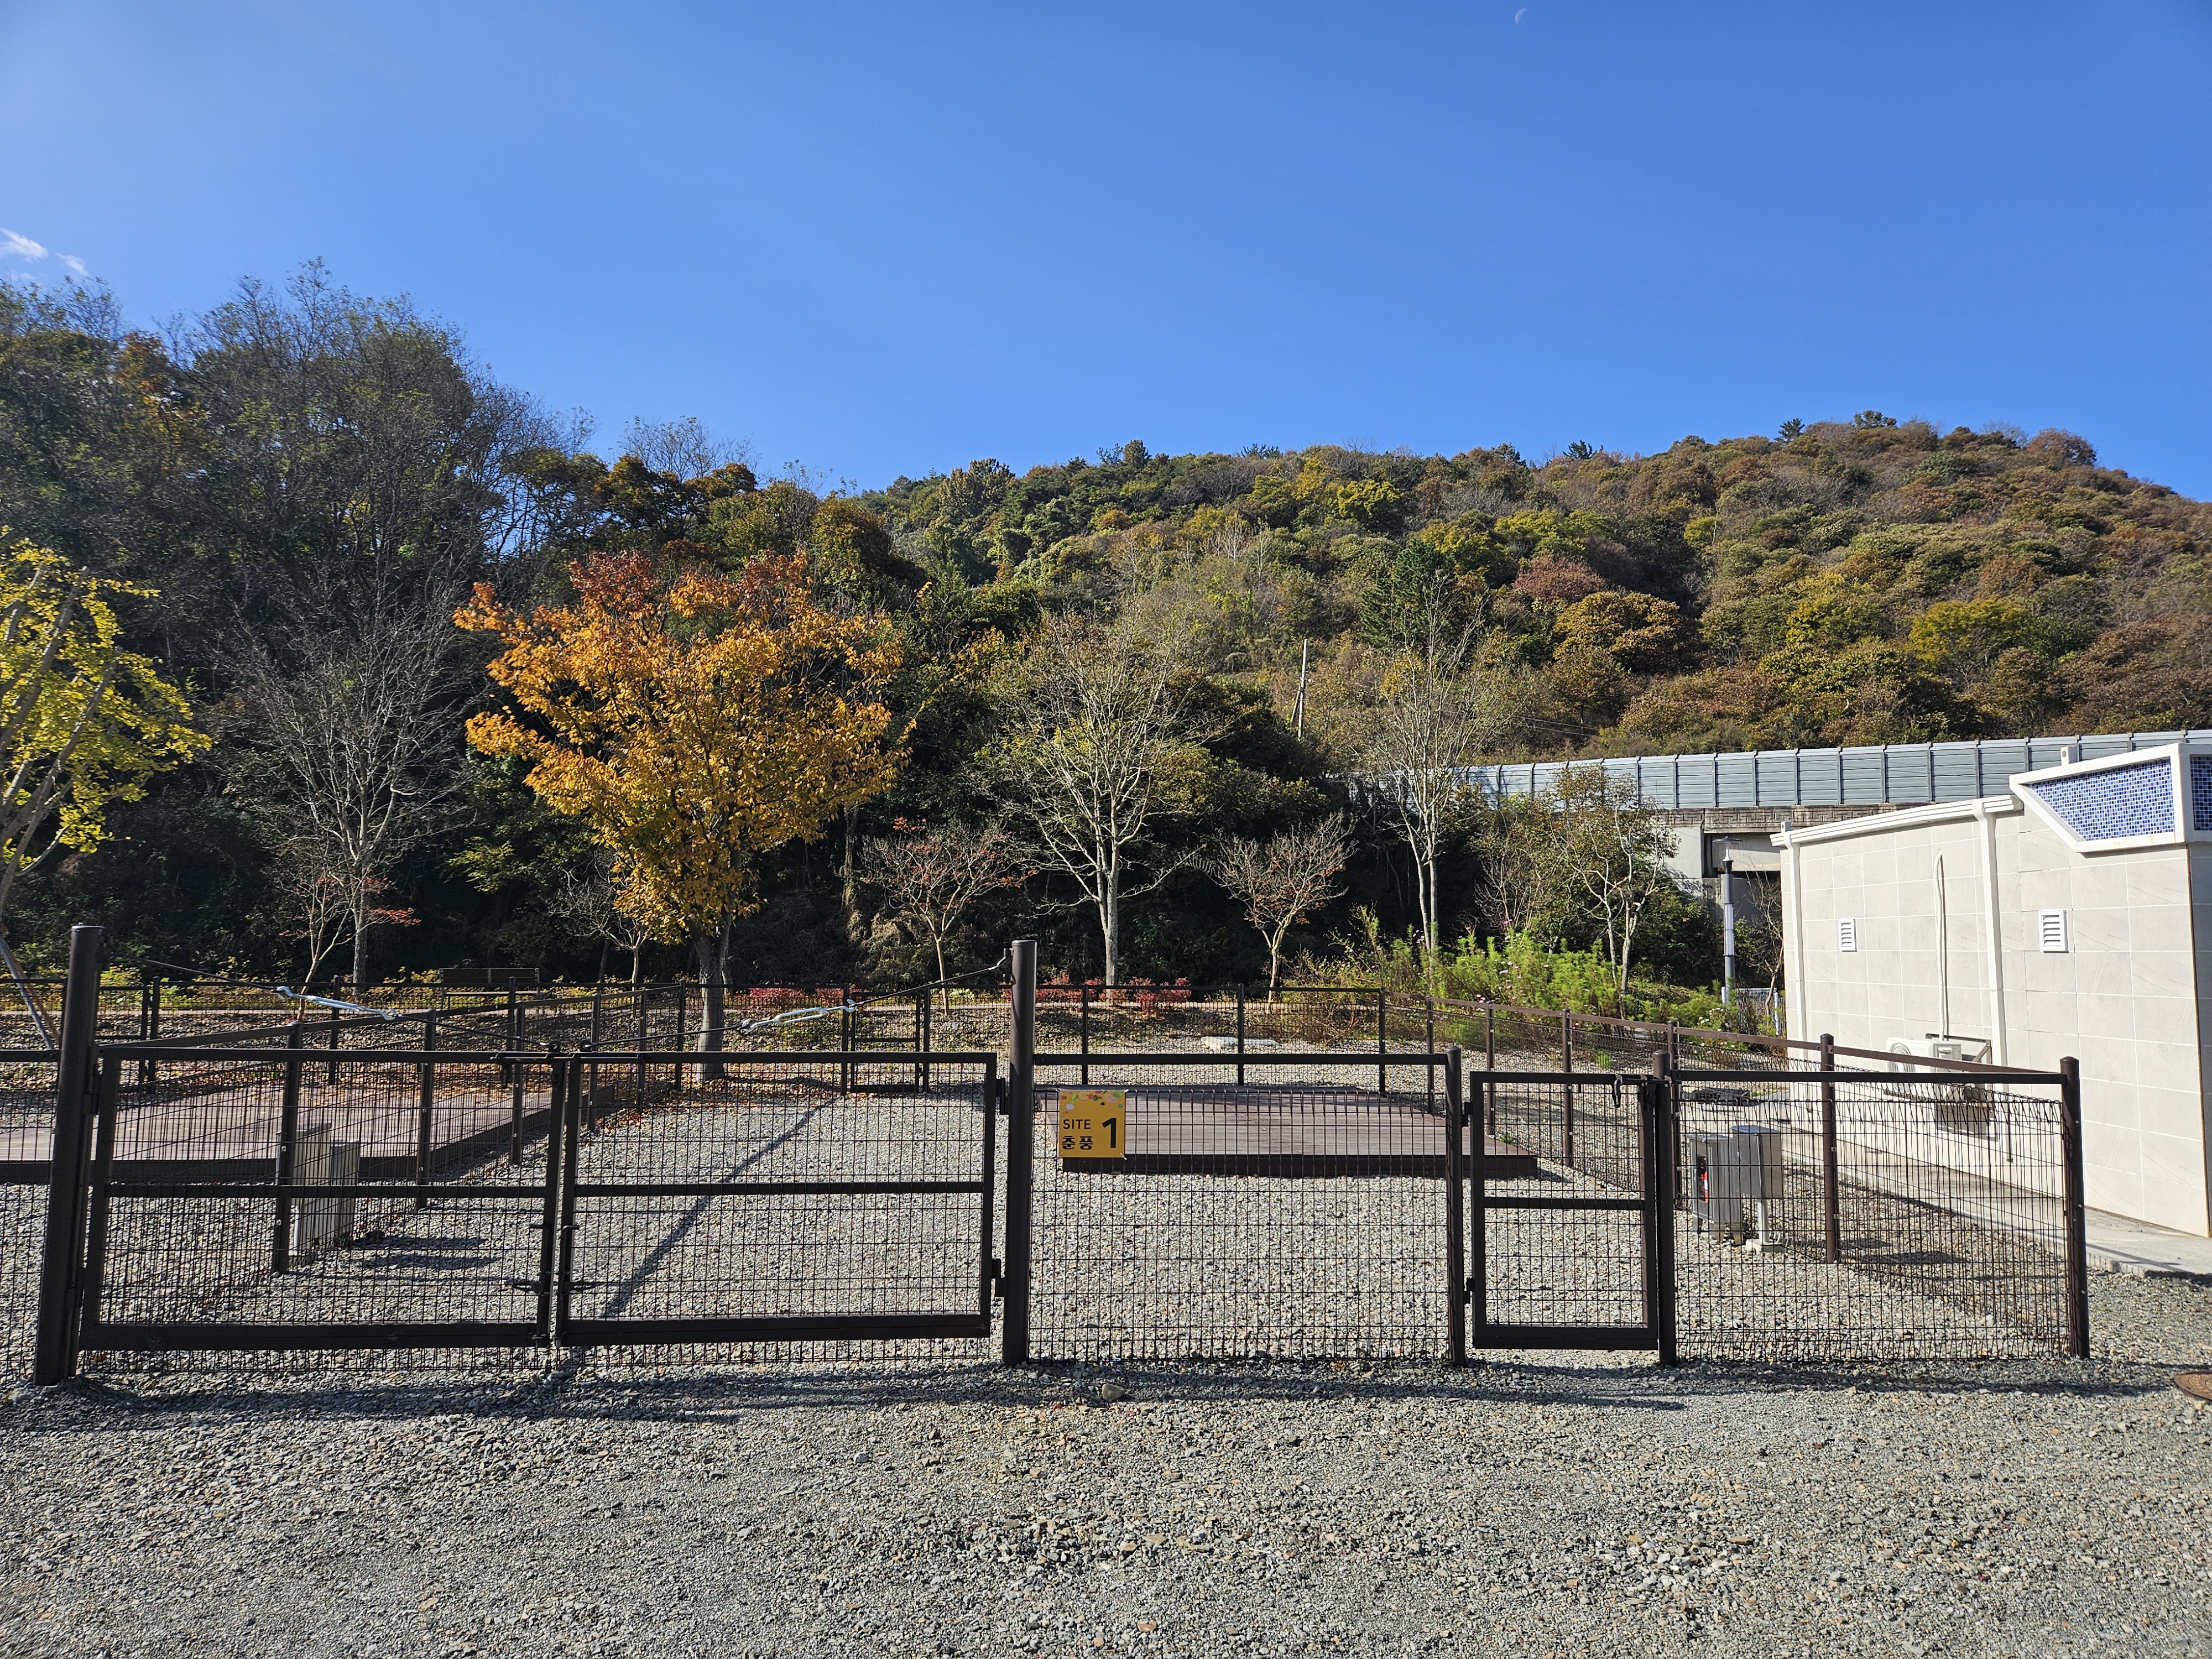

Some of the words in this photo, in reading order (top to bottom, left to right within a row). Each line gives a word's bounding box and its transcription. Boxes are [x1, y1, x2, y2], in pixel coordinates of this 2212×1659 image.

[1063, 1119, 1091, 1129] SITE
[1102, 1118, 1117, 1149] 1
[1061, 1135, 1093, 1150] 춘풍
